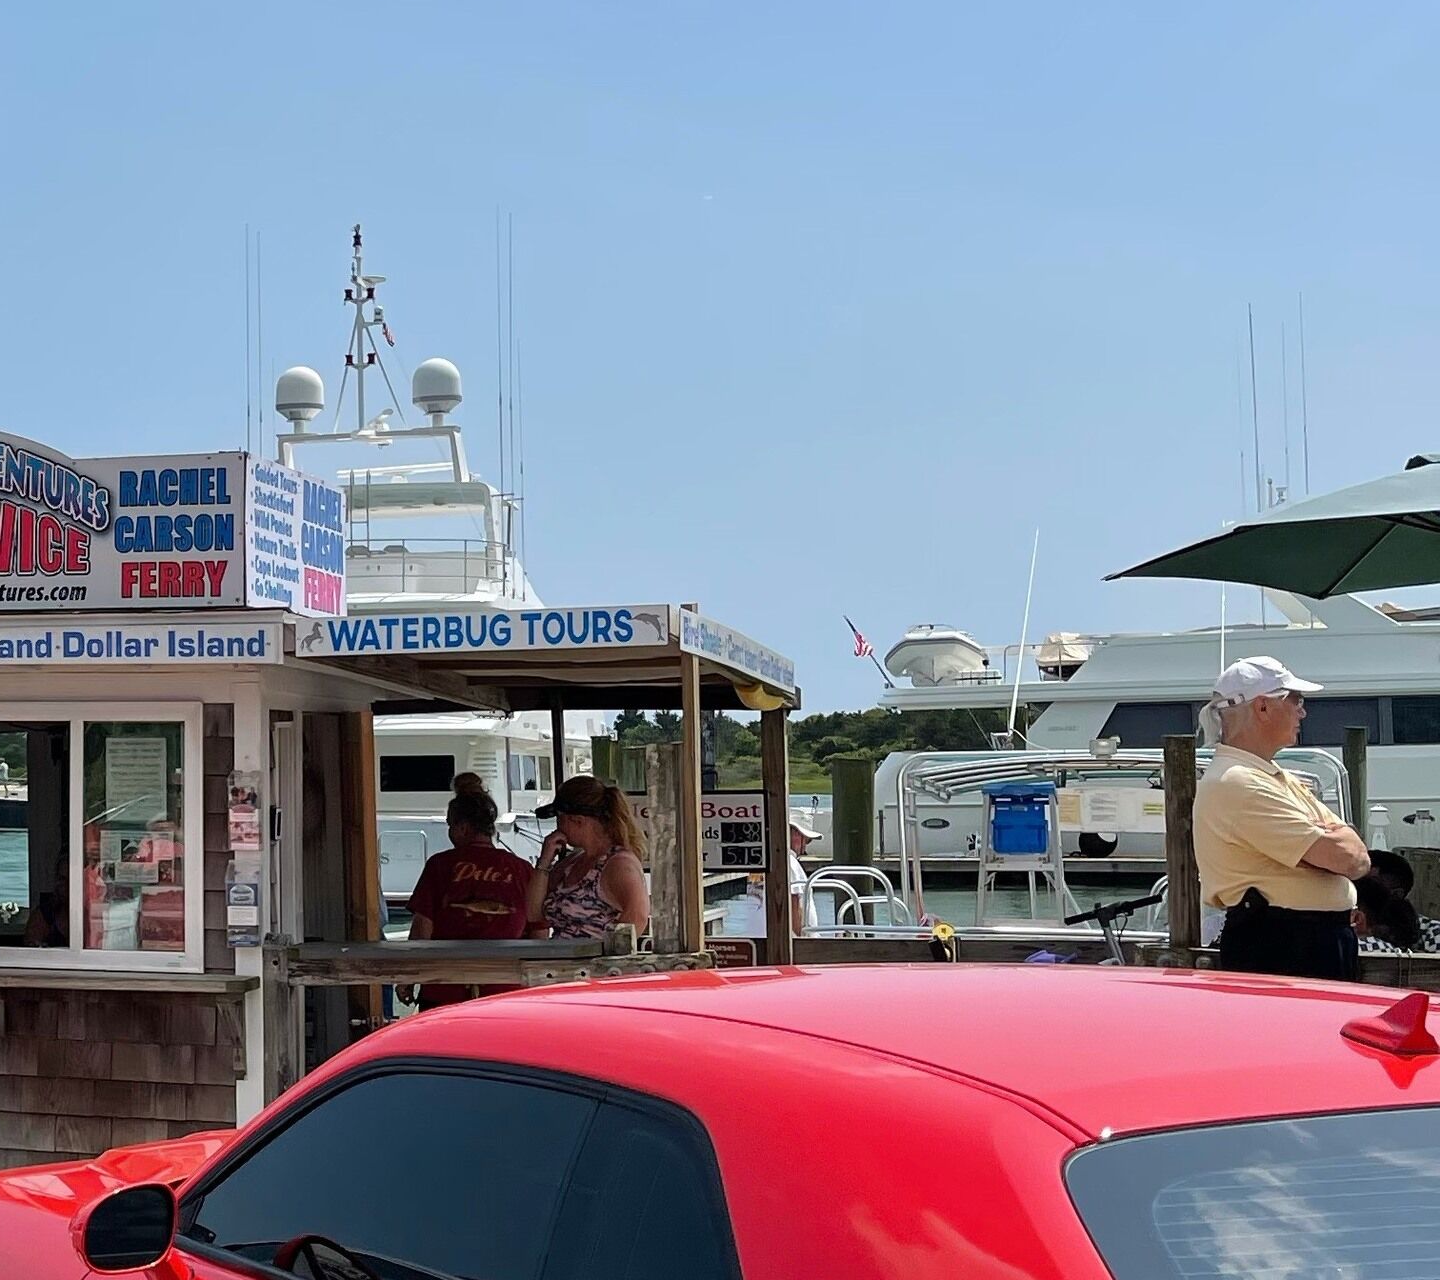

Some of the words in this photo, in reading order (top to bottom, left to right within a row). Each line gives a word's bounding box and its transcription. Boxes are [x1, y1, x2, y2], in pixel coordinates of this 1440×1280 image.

[120, 468, 231, 507] RACHEL
[280, 470, 297, 494] Tours
[303, 479, 342, 532] RACHEL
[115, 514, 234, 553] CARSON
[279, 539, 297, 560] Trails
[301, 523, 344, 575] CARSON
[121, 560, 228, 598] FERRY
[255, 555, 271, 580] Cape
[303, 567, 342, 615] FERRY
[62, 631, 159, 658] Dollar
[168, 630, 265, 657] Island
[327, 614, 511, 651] WATERBUG
[520, 609, 633, 646] TOURS
[701, 802, 761, 819] Boat
[452, 861, 513, 883] Pete's
